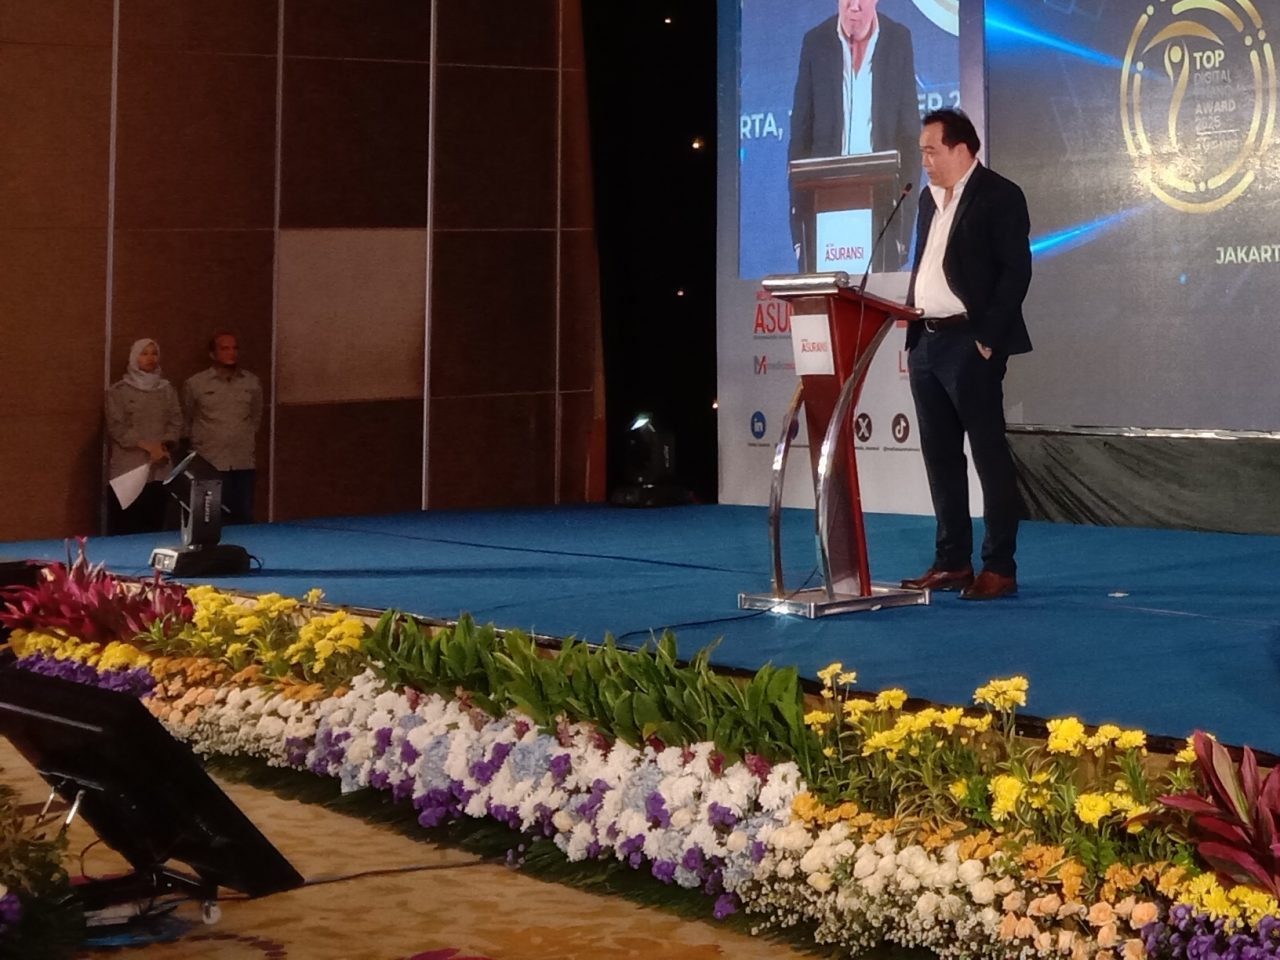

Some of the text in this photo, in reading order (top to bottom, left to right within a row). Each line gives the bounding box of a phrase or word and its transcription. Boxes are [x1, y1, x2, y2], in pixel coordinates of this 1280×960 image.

[1193, 49, 1225, 70] TOP
[1195, 100, 1236, 115] AWARD
[825, 246, 864, 262] ASURANSI
